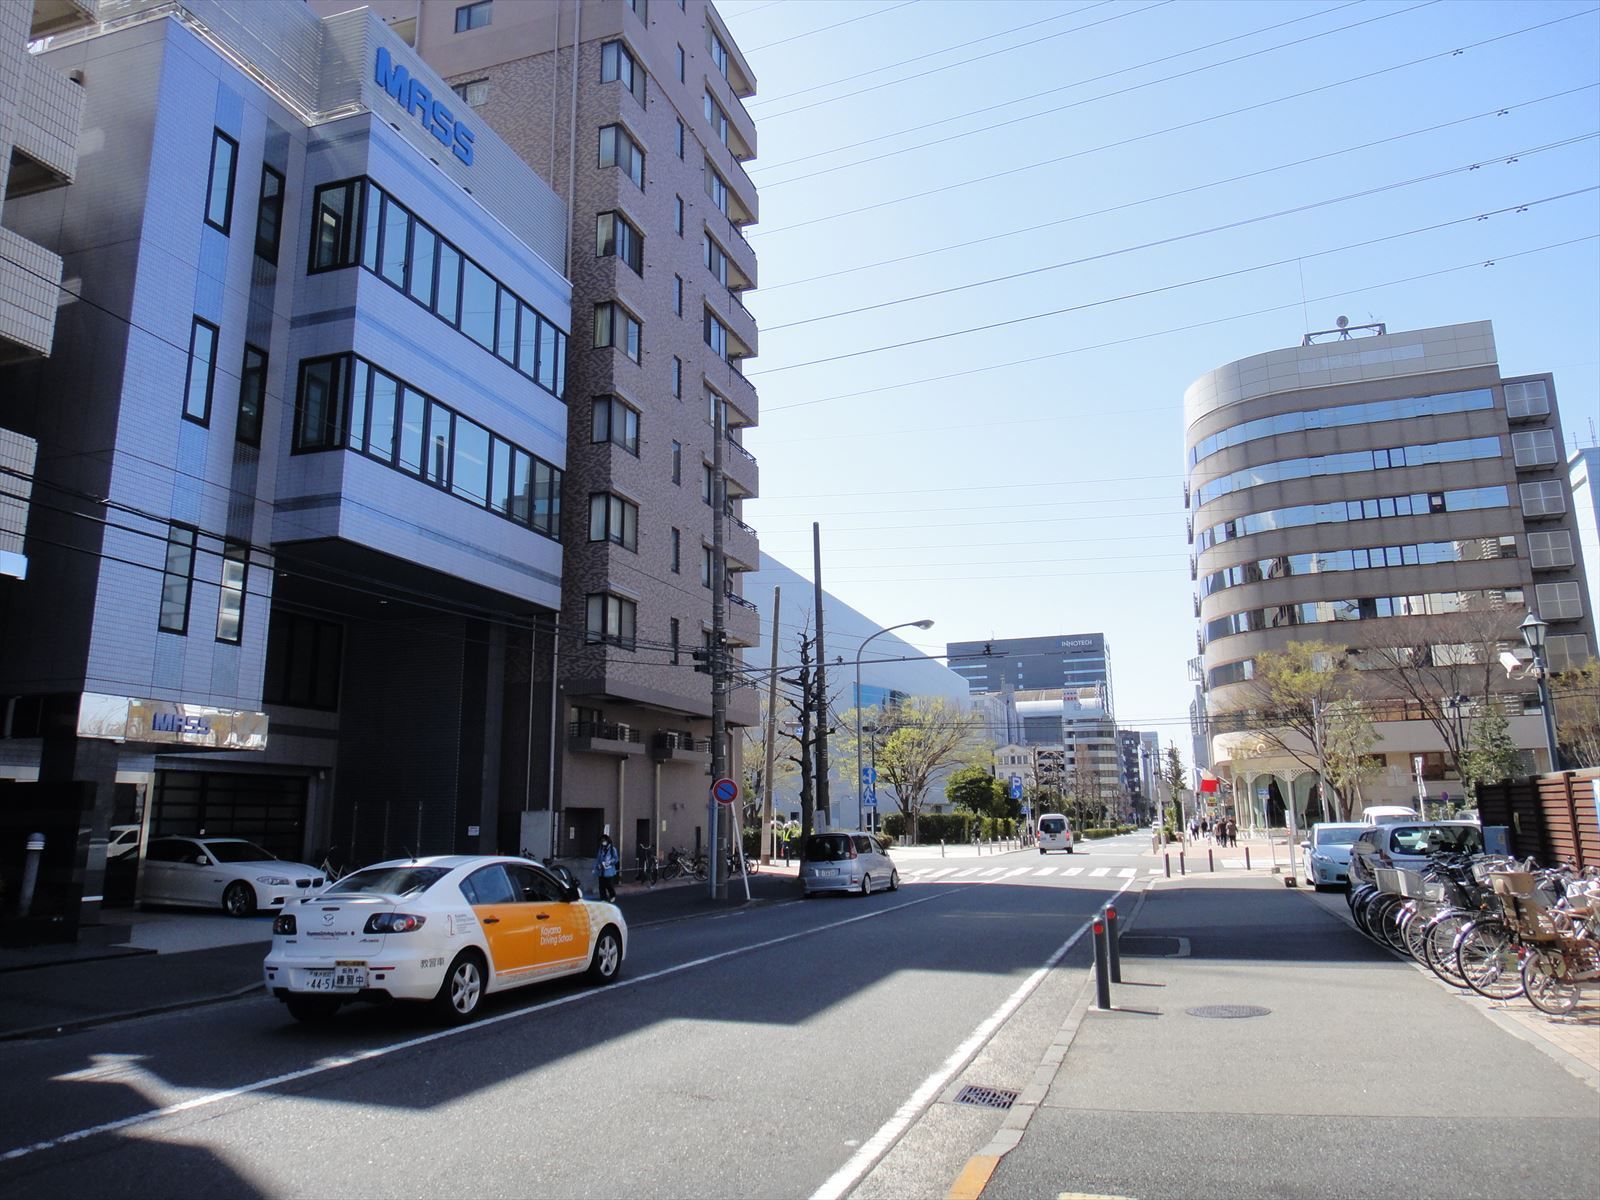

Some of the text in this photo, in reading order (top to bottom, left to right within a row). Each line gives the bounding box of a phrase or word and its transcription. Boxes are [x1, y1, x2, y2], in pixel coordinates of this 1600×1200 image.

[375, 47, 477, 167] MASS
[152, 713, 210, 735] MASS
[1012, 777, 1021, 789] P
[541, 934, 573, 946] Driving School
[336, 974, 364, 985] 練習中
